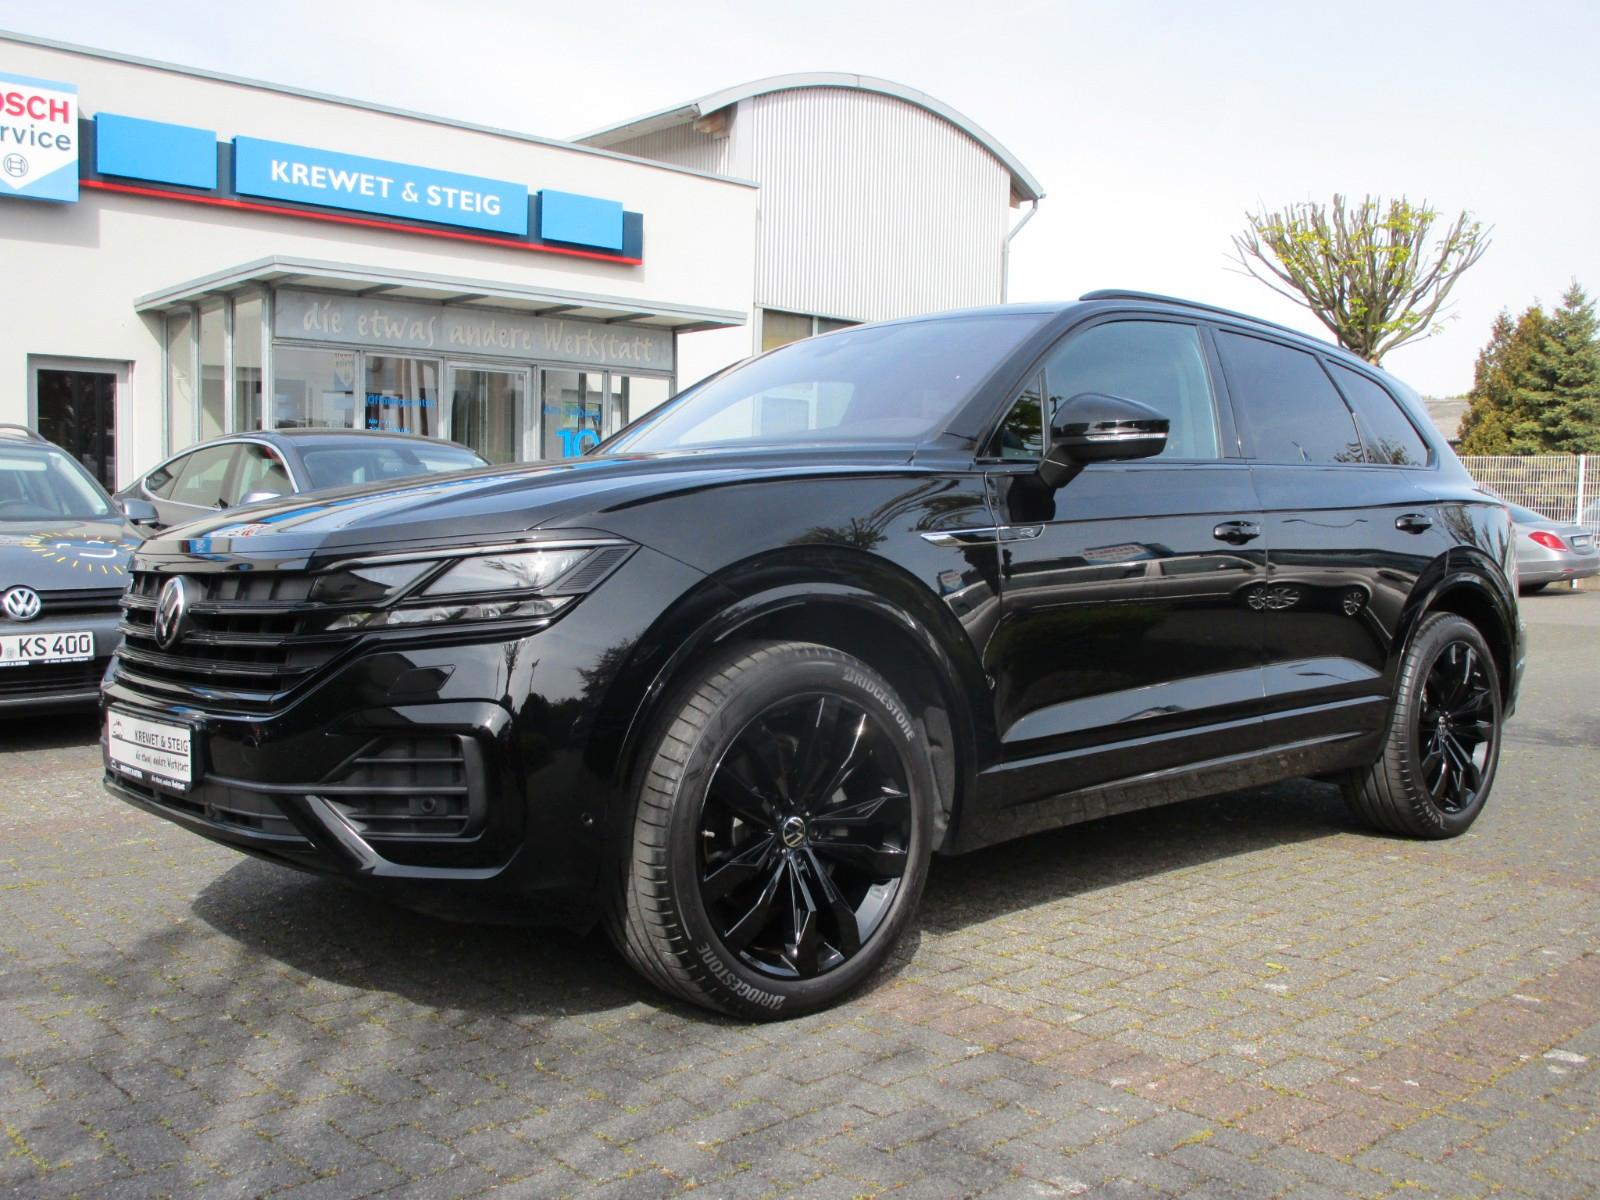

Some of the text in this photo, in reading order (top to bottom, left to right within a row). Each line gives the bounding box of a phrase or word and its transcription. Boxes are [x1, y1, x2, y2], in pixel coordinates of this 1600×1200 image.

[0, 92, 69, 124] SCH
[271, 160, 501, 216] KREWET & STEIG
[303, 300, 655, 362] die etwas andere Werkstatt
[556, 428, 600, 459] 10
[19, 635, 91, 657] KS 400
[842, 667, 915, 741] BRIDGESTONE
[134, 730, 160, 747] KREWET
[167, 737, 188, 752] STEIG
[696, 942, 786, 1010] BRIDGESTONE
